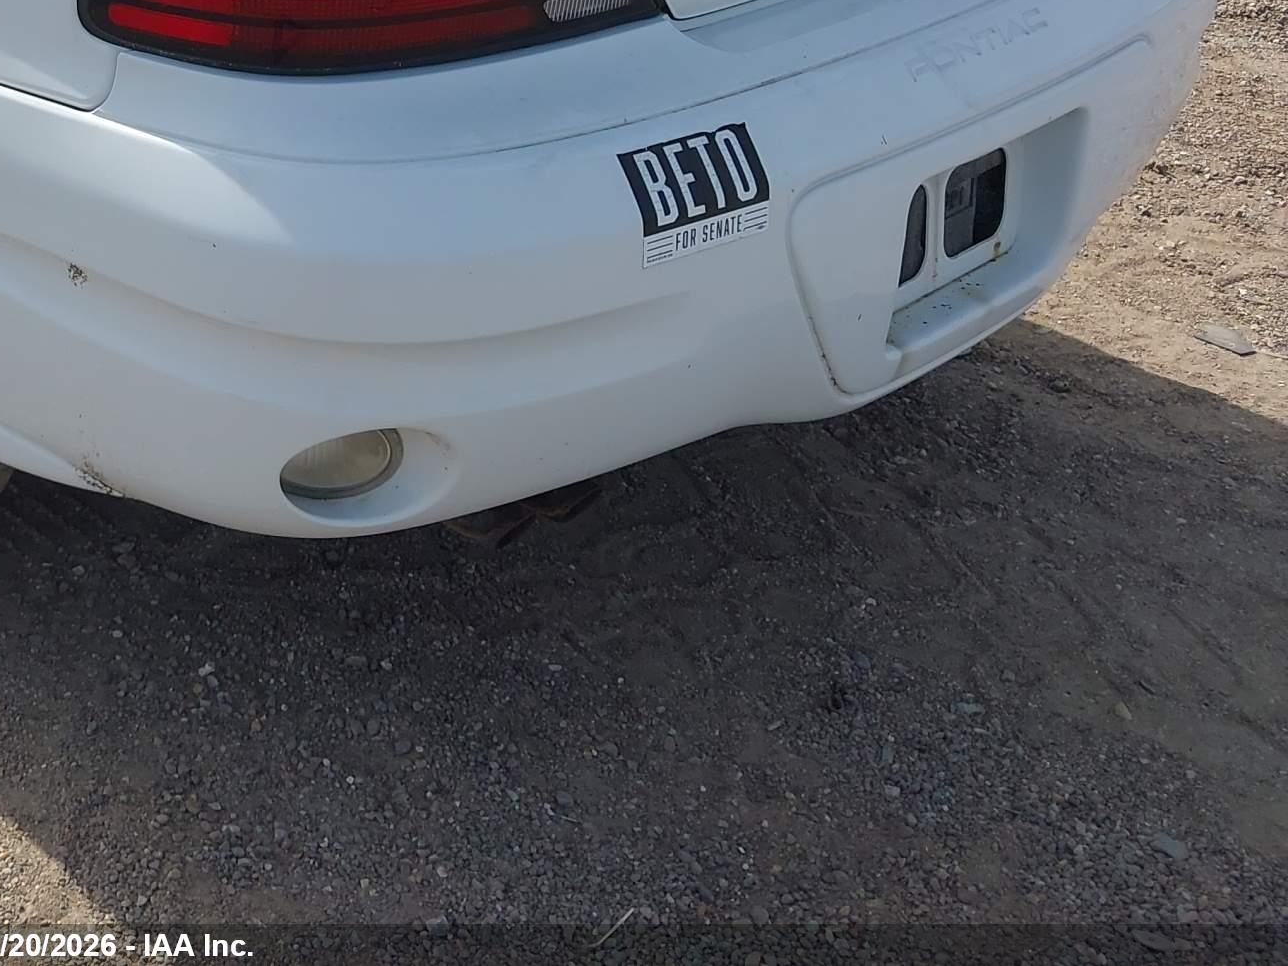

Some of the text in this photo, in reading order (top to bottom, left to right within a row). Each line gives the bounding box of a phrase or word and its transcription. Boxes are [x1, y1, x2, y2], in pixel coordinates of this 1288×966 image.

[904, 7, 1049, 83] PONTIAC
[633, 129, 758, 226] BETO
[675, 214, 743, 251] FOR SENATE
